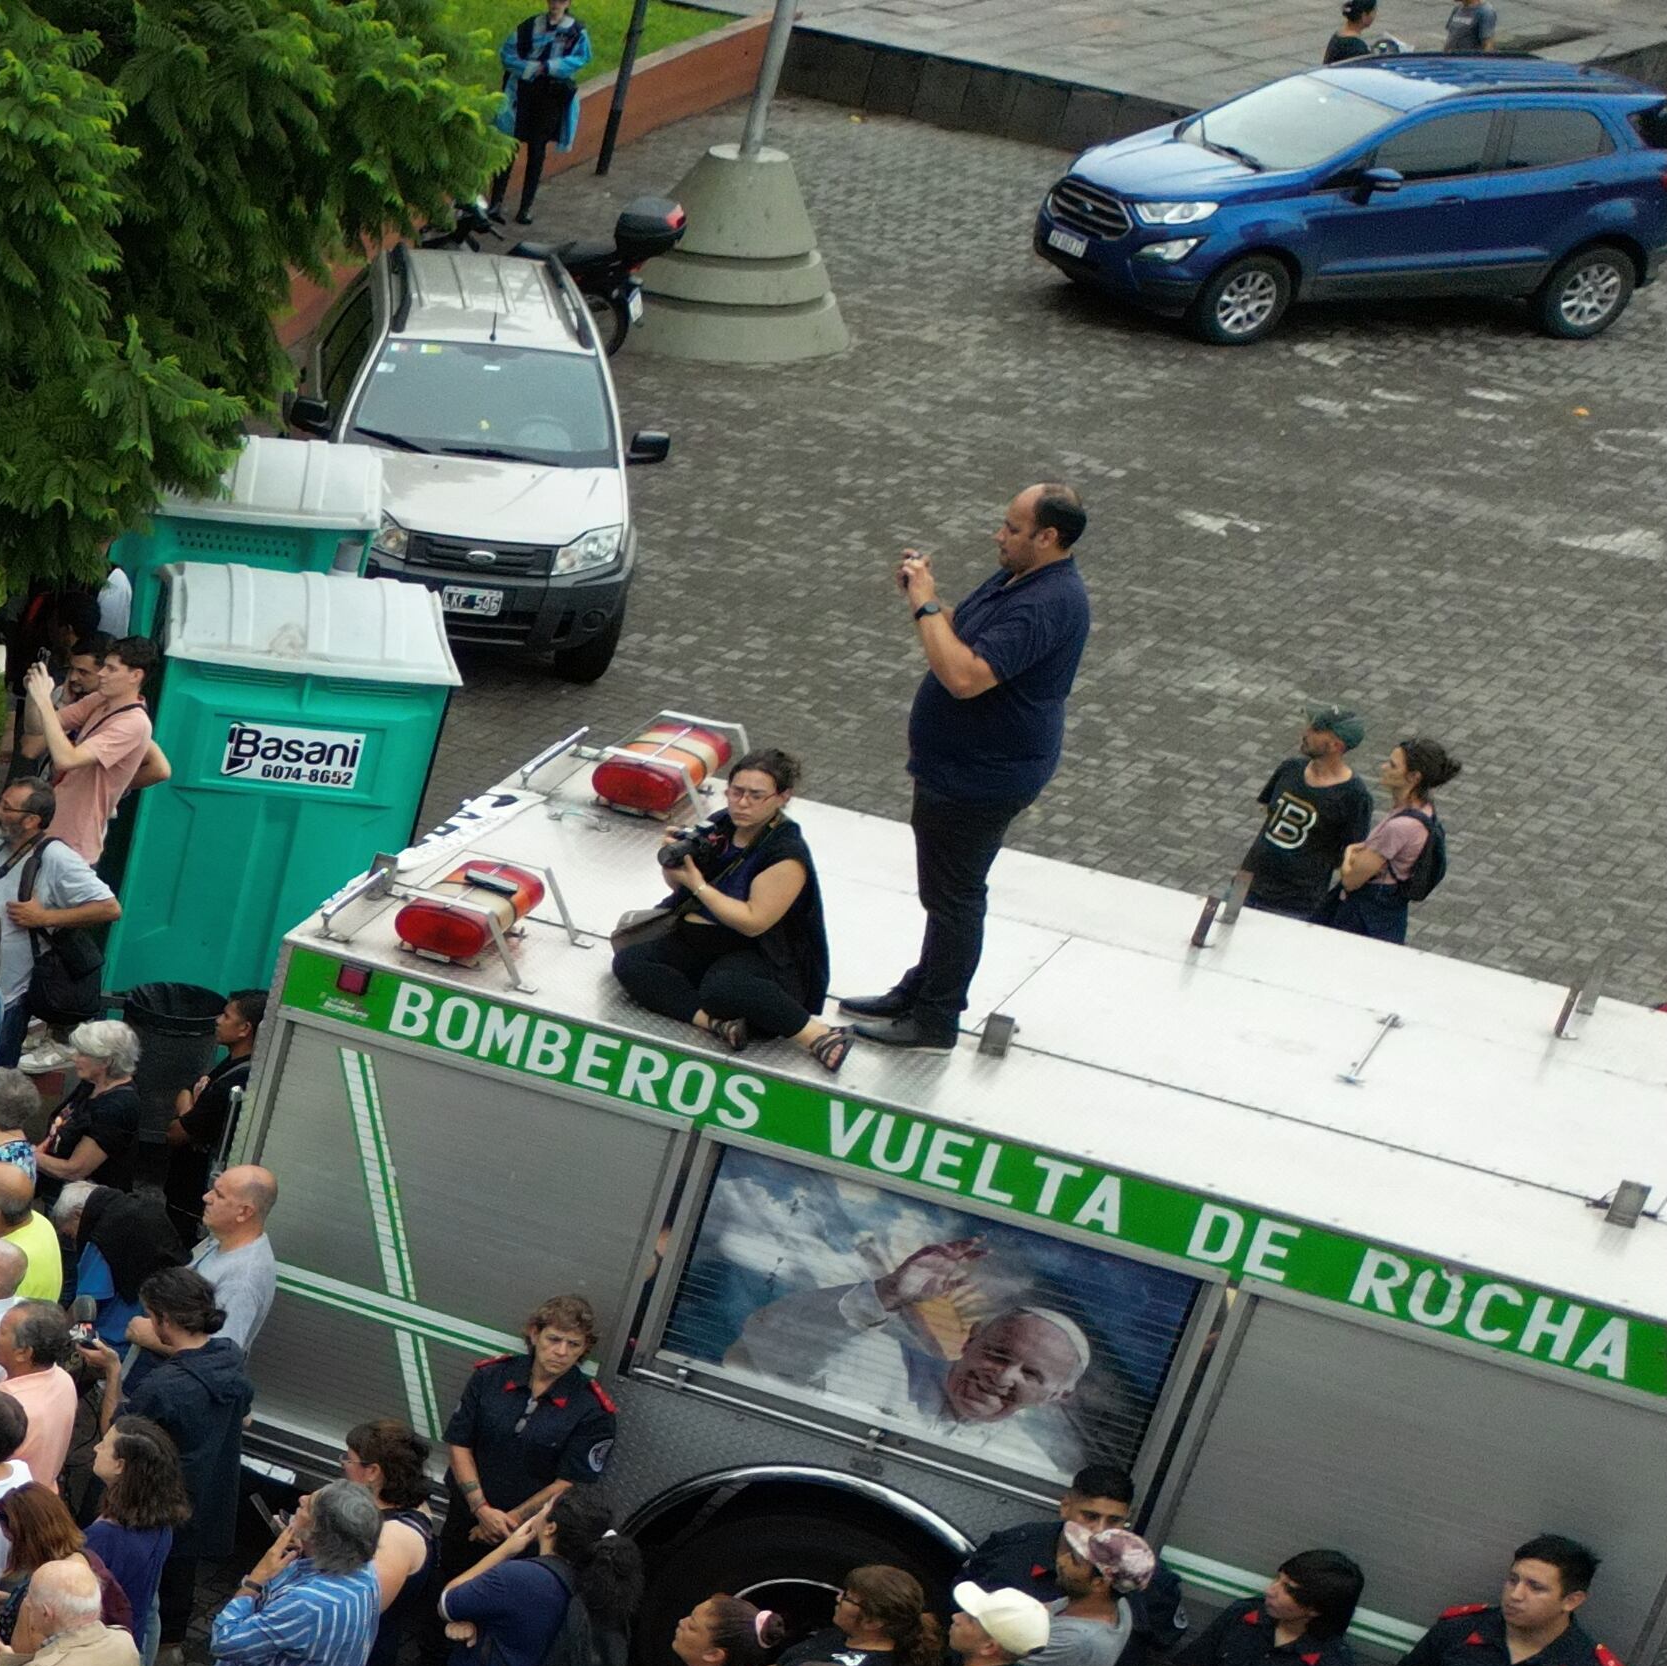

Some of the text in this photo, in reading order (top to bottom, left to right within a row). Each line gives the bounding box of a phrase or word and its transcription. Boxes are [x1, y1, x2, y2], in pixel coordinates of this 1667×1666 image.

[231, 726, 362, 768] Basani
[388, 981, 1630, 1381] BOMBEROS VUELTA DE ROCHA
